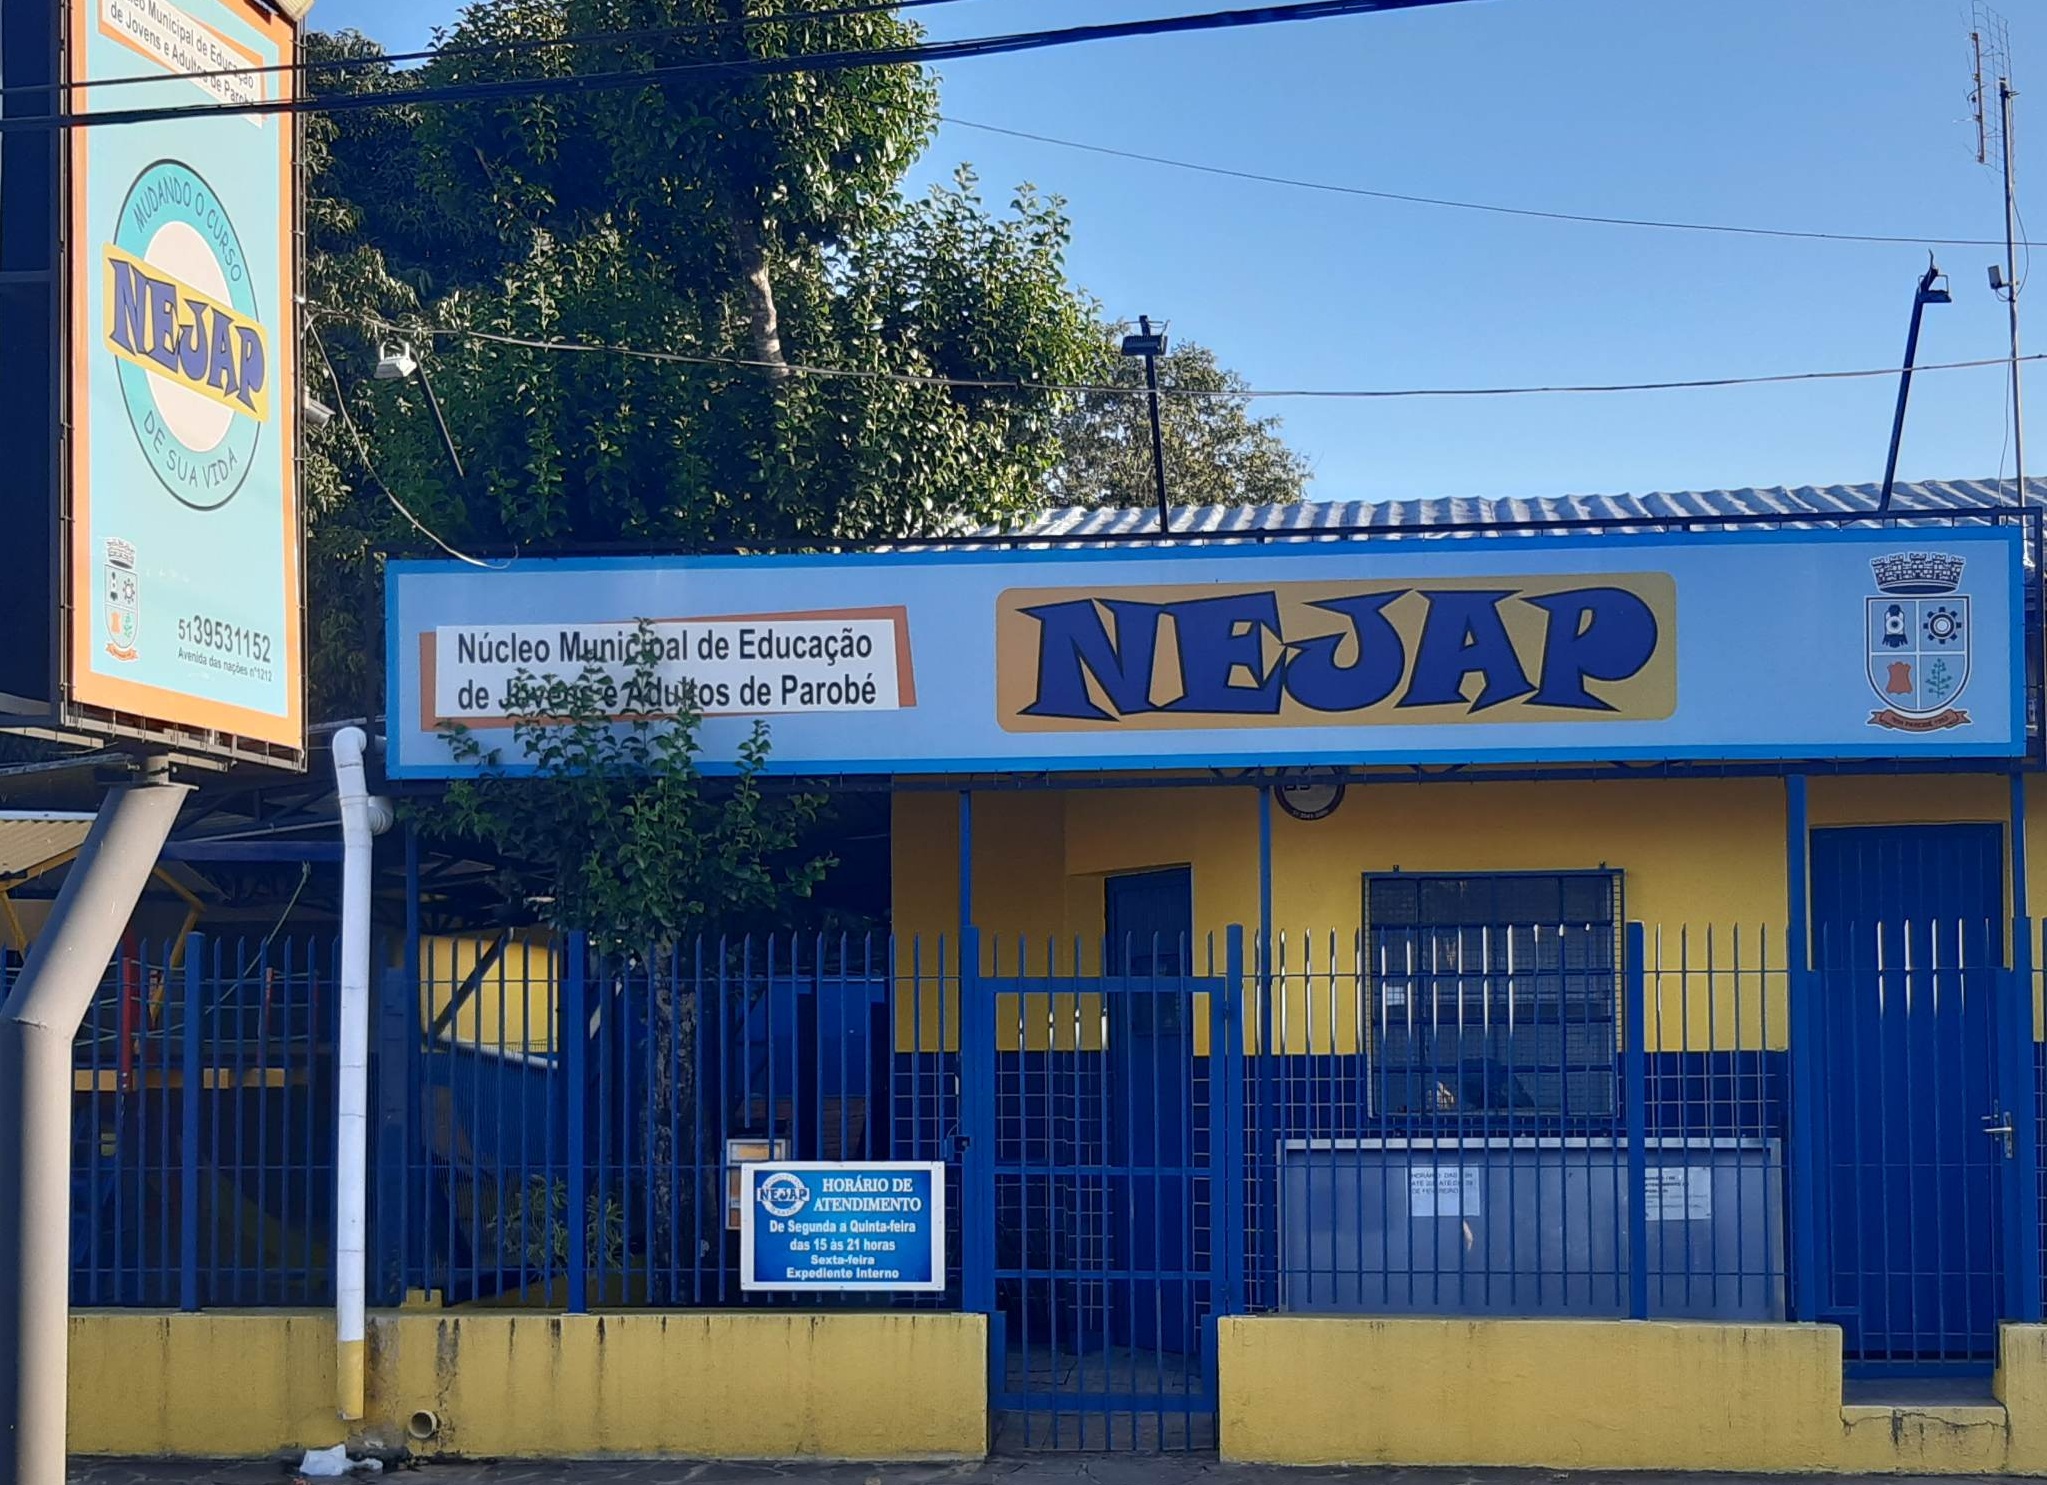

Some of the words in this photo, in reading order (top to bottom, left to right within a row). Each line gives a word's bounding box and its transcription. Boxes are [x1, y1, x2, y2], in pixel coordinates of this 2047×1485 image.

[110, 1, 124, 24] de
[126, 11, 161, 50] Jovens
[163, 42, 170, 56] e
[196, 36, 208, 56] de
[133, 176, 192, 233] MUDANDO
[195, 192, 205, 217] O
[206, 208, 242, 282] CURSO
[108, 257, 265, 413] NEJAP
[143, 410, 166, 454] DE
[166, 450, 198, 488] SUA
[202, 446, 238, 489] VIDA
[458, 632, 551, 664] Núcleo
[697, 629, 730, 660] de
[739, 627, 873, 666] Educação
[1016, 586, 1658, 722] NEJAP
[177, 647, 207, 666] Avenida
[208, 655, 222, 670] das
[458, 679, 489, 709] de
[603, 684, 619, 708] e
[739, 674, 772, 705] de
[781, 673, 877, 706] Parobé
[822, 1174, 889, 1193] HORÁRIO
[892, 1177, 914, 1193] DE
[760, 1188, 808, 1201] NEJAP
[812, 1197, 922, 1213] ATENDIMENTO
[769, 1219, 785, 1234] De
[787, 1219, 837, 1236] Segunda
[841, 1222, 848, 1233] a
[850, 1219, 917, 1234] Quinta-feira
[790, 1238, 810, 1252] das
[813, 1238, 828, 1252] 15
[847, 1238, 861, 1252] 21
[863, 1238, 896, 1252] horas
[810, 1254, 876, 1266] Sexta-feira
[786, 1266, 853, 1281] Expediente
[856, 1266, 900, 1279] Interno
